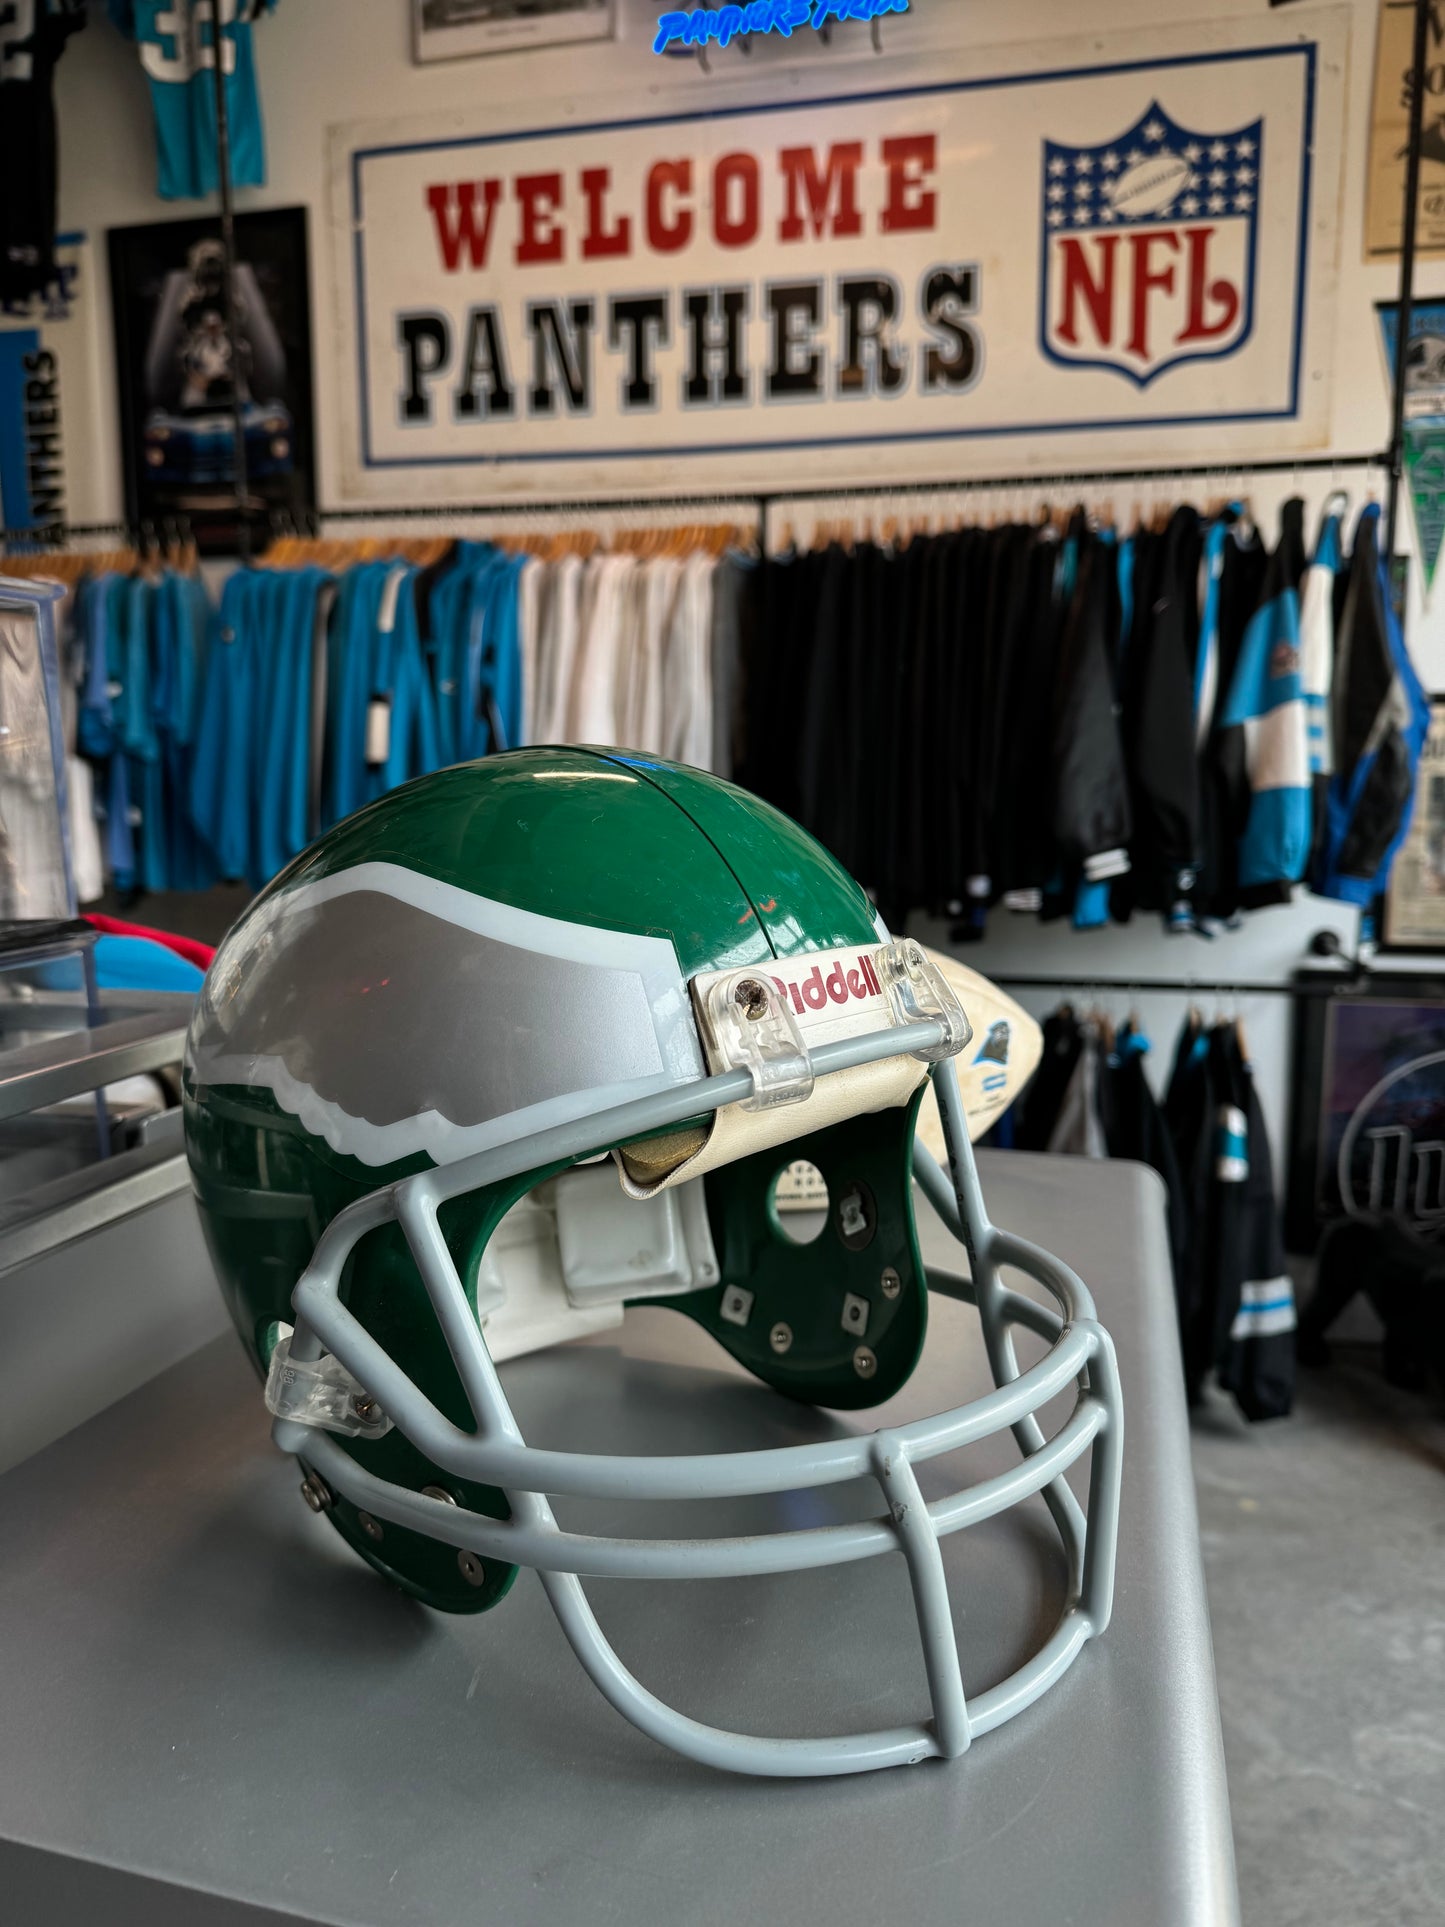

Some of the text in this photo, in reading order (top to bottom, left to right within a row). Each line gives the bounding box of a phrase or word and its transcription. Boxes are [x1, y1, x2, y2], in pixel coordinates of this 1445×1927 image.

[426, 133, 938, 273] WELCOME
[396, 263, 985, 426] PANTHERS
[1055, 226, 1239, 362] NFL
[23, 349, 66, 546] ANTHERS
